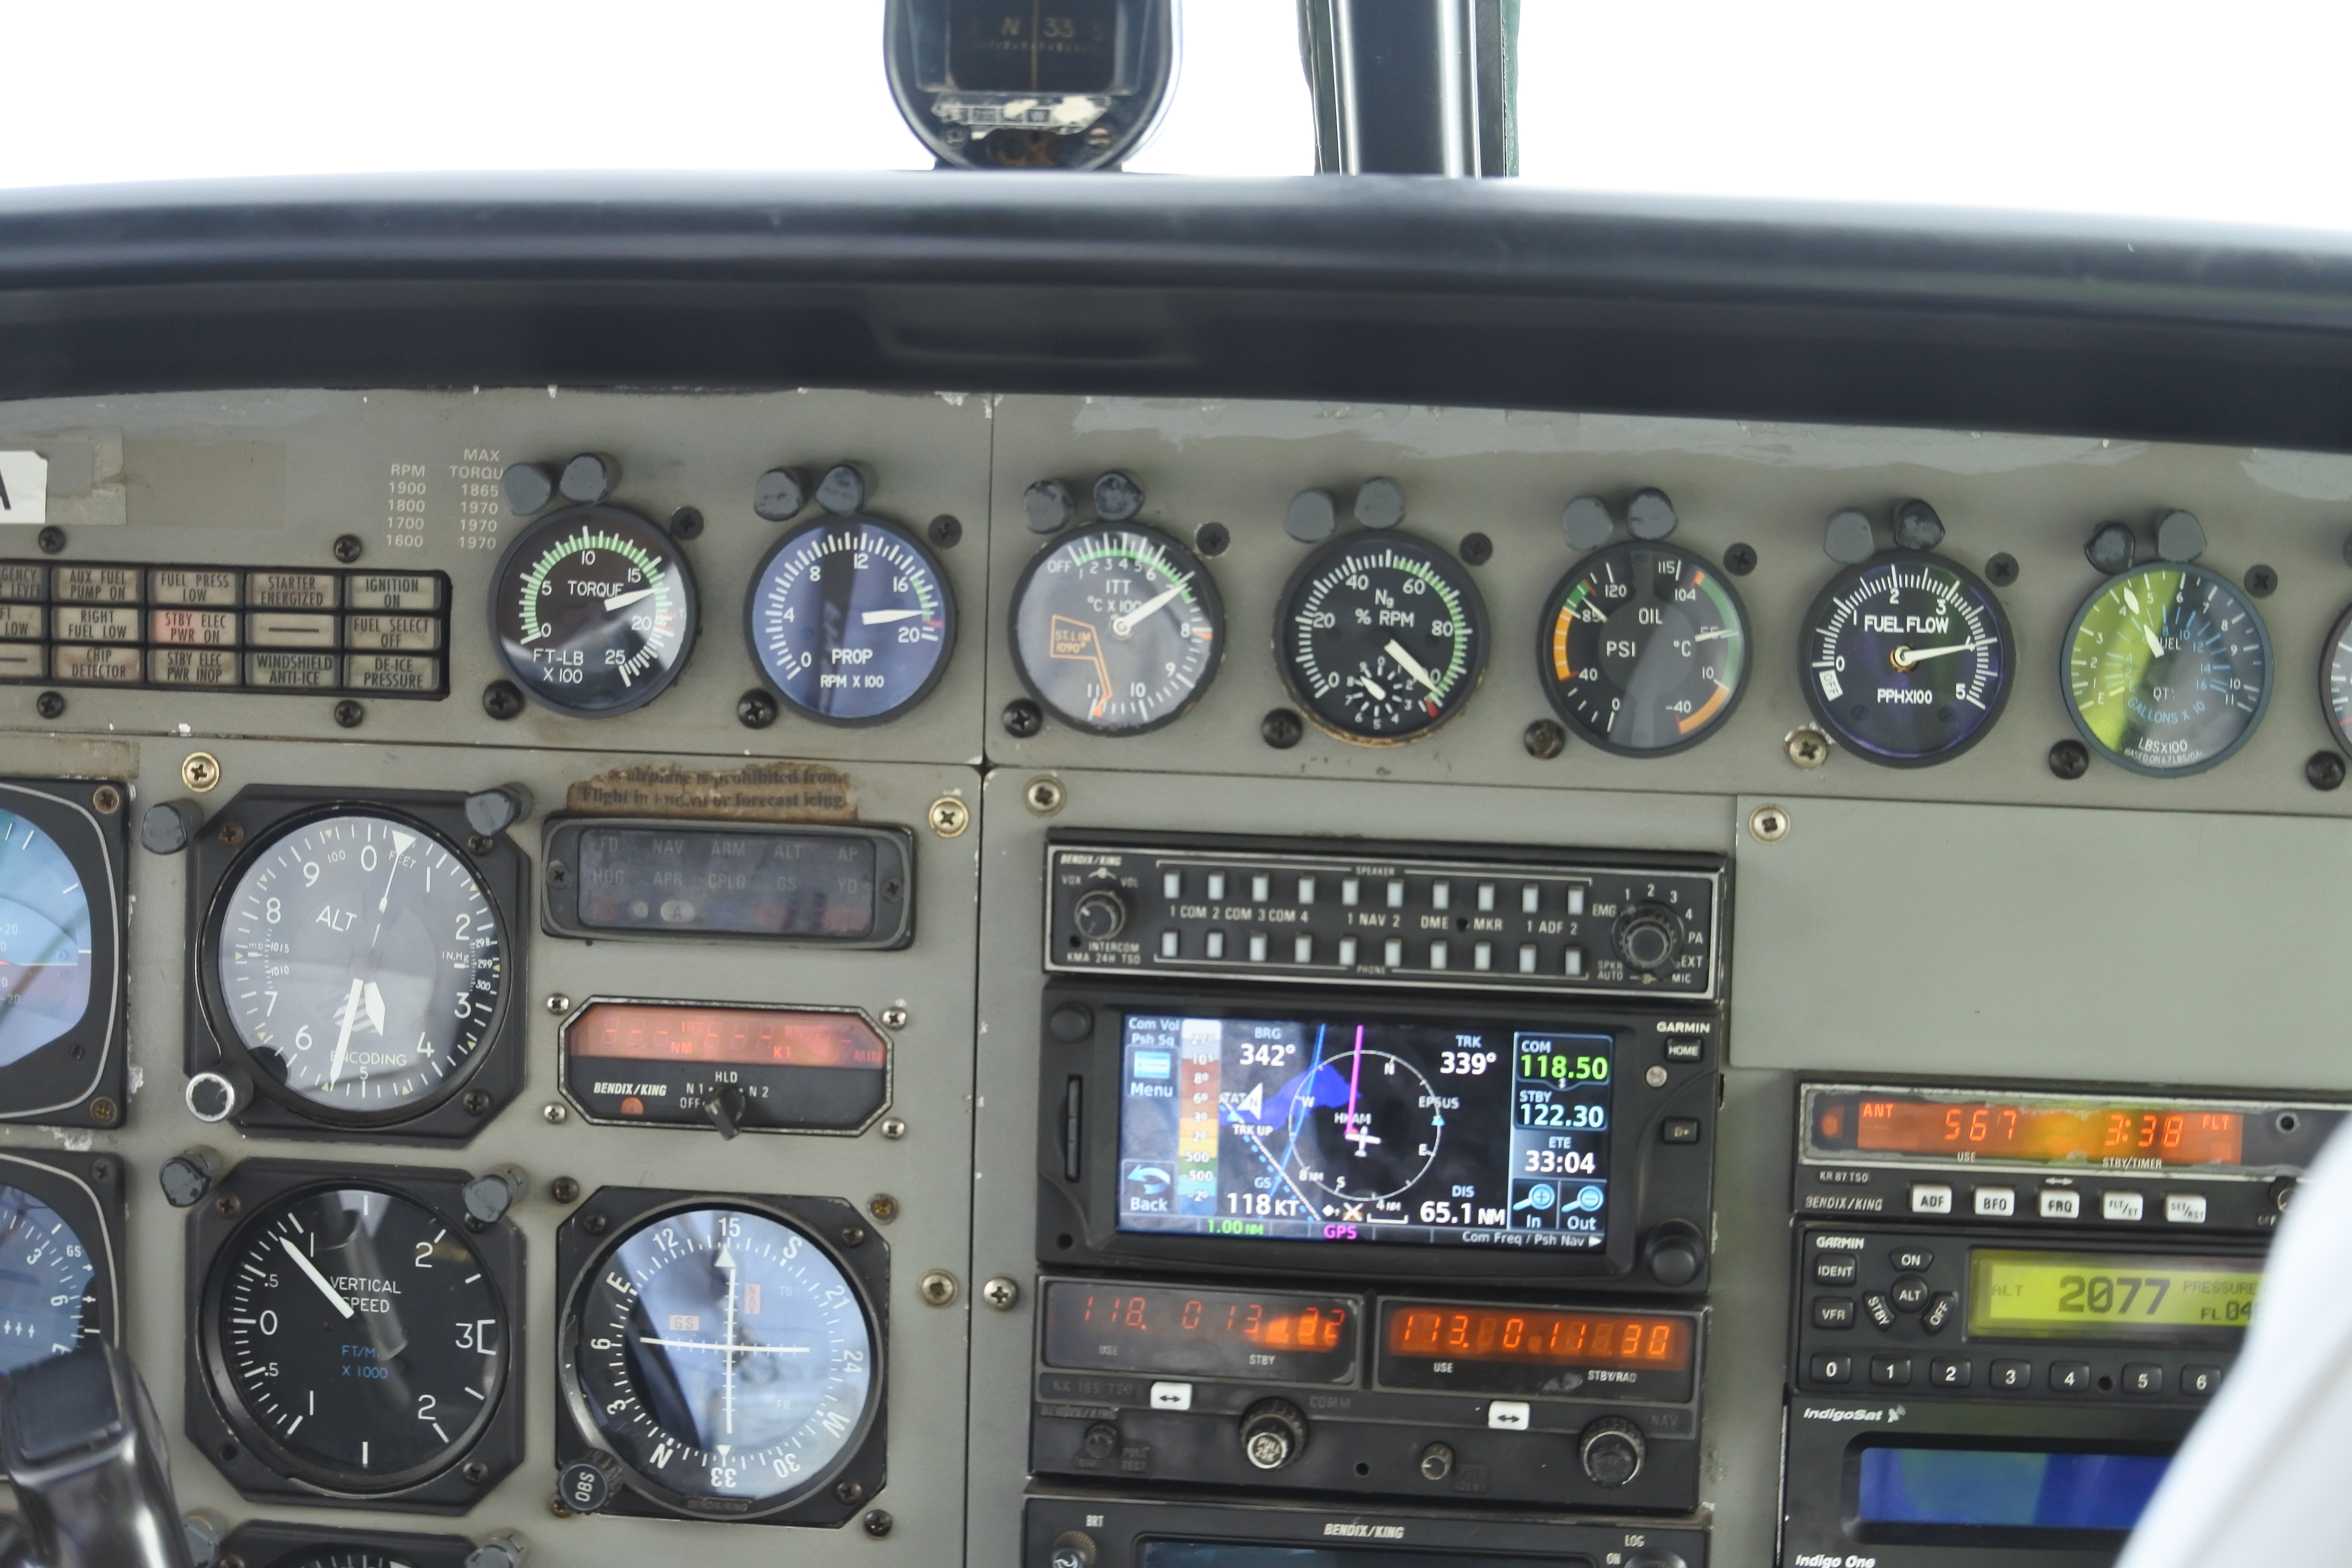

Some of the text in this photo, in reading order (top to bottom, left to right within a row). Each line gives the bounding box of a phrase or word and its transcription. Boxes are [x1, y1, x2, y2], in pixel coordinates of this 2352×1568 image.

[1002, 17, 1075, 37] N 33
[464, 449, 500, 462] MAX
[391, 463, 426, 477] RPM
[449, 465, 504, 480] TORQU
[389, 482, 426, 495] 1900
[462, 483, 499, 497] 1865
[388, 499, 425, 512] 1800
[460, 501, 498, 514] 1970
[387, 517, 425, 530] 1700
[460, 519, 497, 532] 1970
[387, 534, 423, 547] 1600
[459, 536, 496, 549] 1970
[1047, 560, 1072, 573] OFF
[1658, 561, 1674, 574] 115
[70, 570, 125, 584] AUX FUEL
[161, 572, 229, 588] FUEL PRESS
[269, 575, 315, 590] STARTER
[628, 568, 641, 583] 15
[366, 578, 418, 592] IGNITION
[568, 580, 624, 597] TORQUE
[1105, 579, 1132, 595] ITT
[1606, 584, 1627, 597] 120
[71, 586, 125, 600] PUMP ON
[183, 589, 207, 602] LOW
[261, 591, 323, 606] ENERGIZED
[1675, 588, 1696, 602] 104
[384, 594, 400, 608] ON
[81, 610, 114, 623] RIGHT
[166, 612, 226, 629] STBY ELEC
[1639, 608, 1663, 625] OIL
[69, 624, 126, 639] FUEL LOW
[354, 618, 429, 633] FUEL SELECT
[1865, 615, 1949, 634] FUEL FLOW
[171, 628, 220, 643] PWR ON
[381, 634, 401, 648] OFF
[87, 648, 111, 662] CHIP
[832, 648, 873, 664] PROP
[1606, 641, 1635, 657] PSI
[167, 652, 221, 667] STBY ELEC
[257, 655, 332, 670] WINDSHIELD
[534, 648, 584, 666] FT-LB
[72, 663, 126, 678] DETECTOR
[375, 658, 413, 673] DE-ICE
[167, 667, 222, 683] PWR INOP
[270, 671, 319, 686] ANTI-ICE
[364, 672, 422, 688] PRESSURE
[543, 667, 583, 684] X 100
[820, 675, 885, 688] RPM X 100
[1822, 673, 1839, 697] OFF
[2128, 697, 2178, 724] GALLONS
[2193, 700, 2205, 715] 10
[583, 787, 627, 806] Flight
[735, 792, 799, 807] forecast
[711, 841, 745, 857] ARM
[774, 844, 803, 859] ALT
[388, 852, 417, 869] FEET
[593, 869, 624, 885] HDG
[1356, 866, 1395, 877] SPEAKER
[708, 873, 746, 890] CPLD
[1592, 903, 1617, 917] EMG
[315, 905, 357, 932] ALT
[1421, 917, 1448, 930] DME
[1474, 918, 1503, 931] MKR
[1688, 932, 1703, 945] PA
[271, 942, 289, 953] 1015
[1088, 942, 1139, 953] INTERCOM
[1681, 955, 1703, 968] EXT
[271, 965, 289, 976] 1010
[1129, 1018, 1179, 1031] Com Vol
[1656, 1021, 1710, 1033] GARMIN
[1255, 1027, 1281, 1039] BRG
[1456, 1035, 1482, 1048] TRK
[1522, 1040, 1552, 1053] COM
[1239, 1044, 1295, 1067] 342°
[1669, 1045, 1698, 1056] HOME
[330, 1050, 408, 1066] ENCODING
[1440, 1051, 1497, 1075] 339°
[1521, 1054, 1608, 1080] 118.50
[715, 1071, 738, 1083] HLD
[593, 1082, 667, 1097] BENDIX/KING
[1130, 1083, 1173, 1097] Menu
[1519, 1091, 1552, 1102] STBY
[680, 1097, 700, 1108] OFF
[1520, 1104, 1604, 1127] 122.30
[1863, 1103, 1893, 1118] ANT
[2202, 1115, 2230, 1130] FLT
[1549, 1136, 1571, 1149] ETE
[1524, 1150, 1596, 1174] 33:04
[1957, 1151, 1976, 1162] USE
[2103, 1156, 2162, 1169] STBY/TIMER
[1254, 1176, 1272, 1189] GS
[1452, 1185, 1475, 1198] DIS
[1131, 1198, 1168, 1212] Back
[1227, 1192, 1300, 1216] 118 KT
[1805, 1196, 1882, 1211] BENDIX/KING
[1921, 1195, 1944, 1207] ADF
[1420, 1200, 1505, 1225] 65.1 NM
[718, 1217, 741, 1237] 15
[1527, 1214, 1541, 1228] In
[1568, 1216, 1596, 1230] Out
[1324, 1225, 1358, 1240] GPS
[653, 1228, 678, 1252] 12
[1816, 1236, 1865, 1250] GARMIN
[1901, 1254, 1921, 1266] ON
[1818, 1265, 1853, 1277] IDENT
[330, 1276, 402, 1294] VERTICAL
[780, 1286, 792, 1297] TO
[2183, 1280, 2257, 1295] PRESSURE
[1899, 1290, 1921, 1301] ALT
[2058, 1276, 2171, 1315] 2077
[343, 1297, 390, 1313] SPEED
[1868, 1296, 1890, 1325] STBY
[1822, 1309, 1846, 1320] VFR
[1930, 1301, 1948, 1326] OFF
[675, 1318, 694, 1330] GS
[1250, 1355, 1275, 1365] STBY
[1434, 1362, 1453, 1373] USE
[1587, 1370, 1637, 1383] STBY/RAD
[777, 1399, 790, 1410] FR
[1803, 1407, 1883, 1422] IndigoSat
[575, 1472, 595, 1502] OBS
[1086, 1515, 1104, 1527] BRT
[1324, 1523, 1405, 1540] BENDIX/KING
[1625, 1534, 1645, 1548] LOG
[1795, 1555, 1875, 1568] Indigo One
